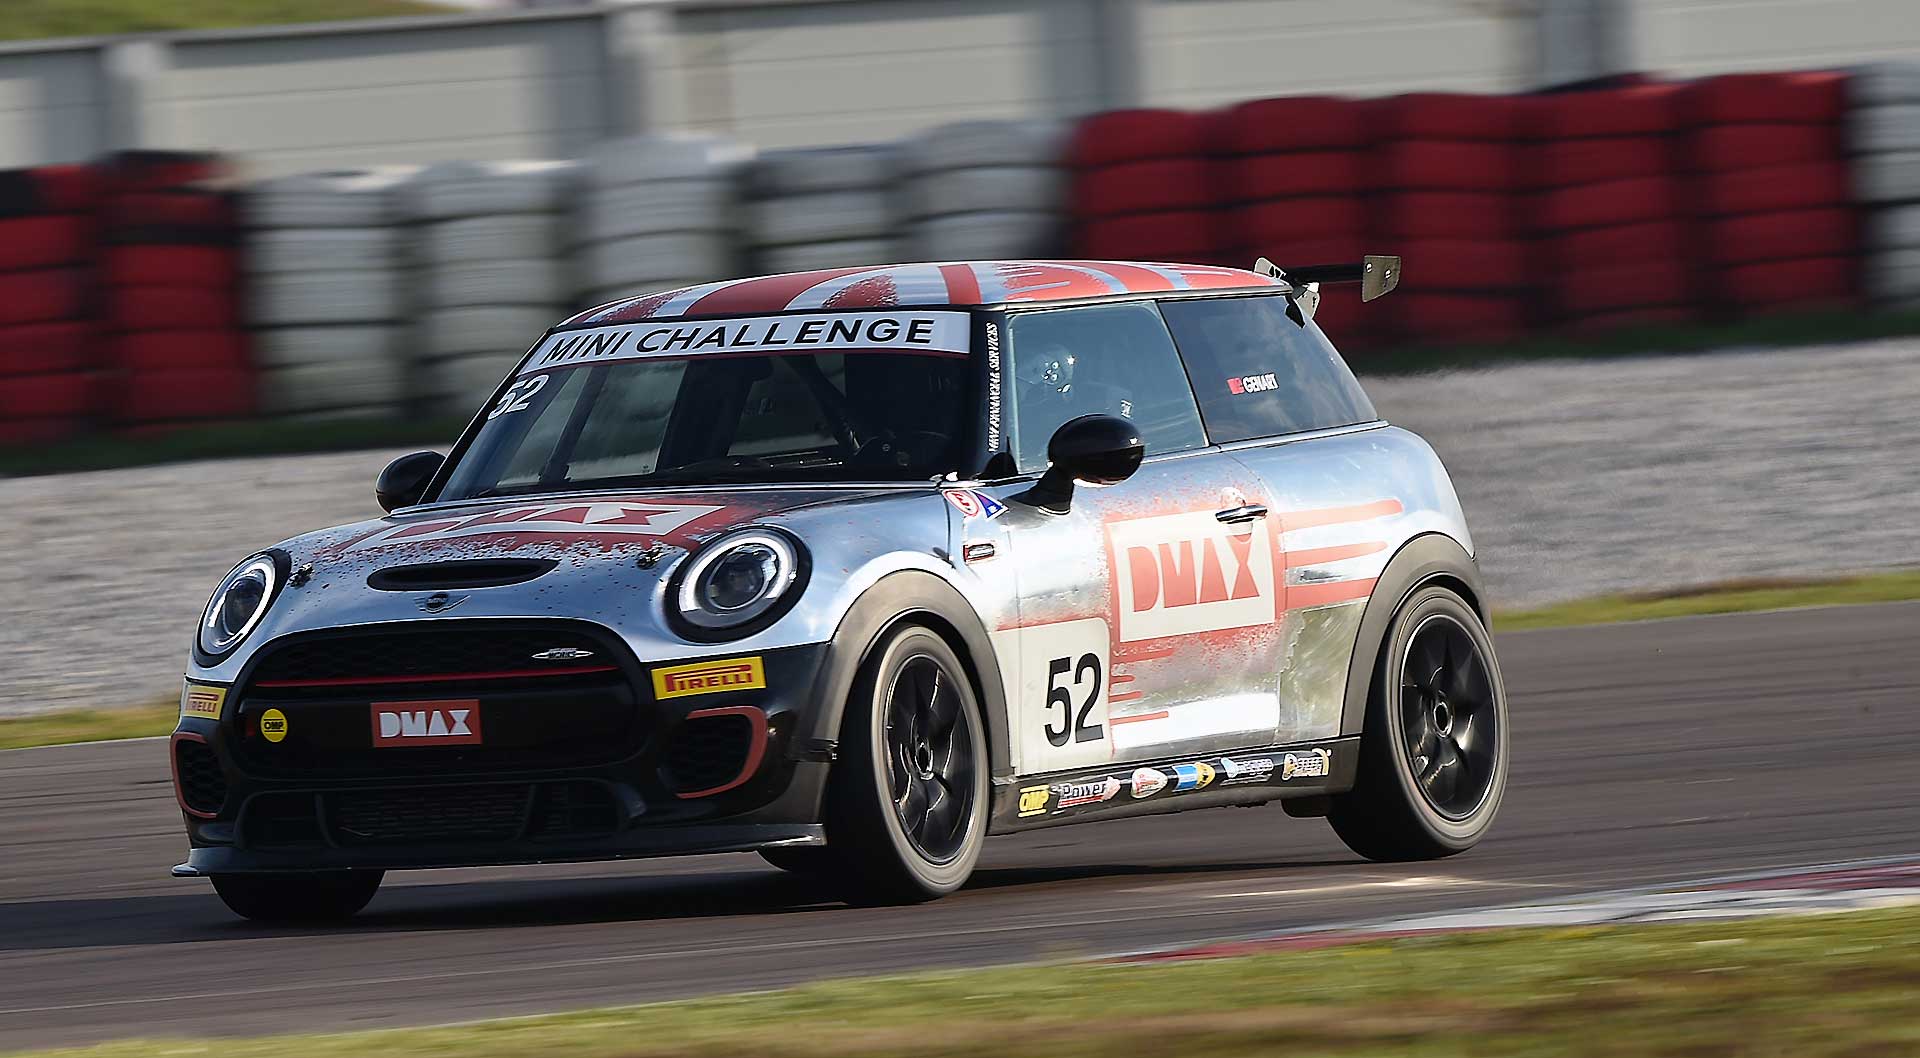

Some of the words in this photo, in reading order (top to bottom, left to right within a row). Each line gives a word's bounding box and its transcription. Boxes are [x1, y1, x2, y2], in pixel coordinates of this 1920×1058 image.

[539, 331, 632, 365] MINI
[636, 317, 934, 353] CHALLENGE
[986, 322, 1000, 371] SERVICES
[487, 374, 550, 420] 52
[1126, 532, 1260, 613] DMAX
[664, 664, 753, 692] PIRELLI
[1044, 652, 1104, 748] 52
[263, 720, 285, 731] OMP
[379, 709, 473, 738] DMAX
